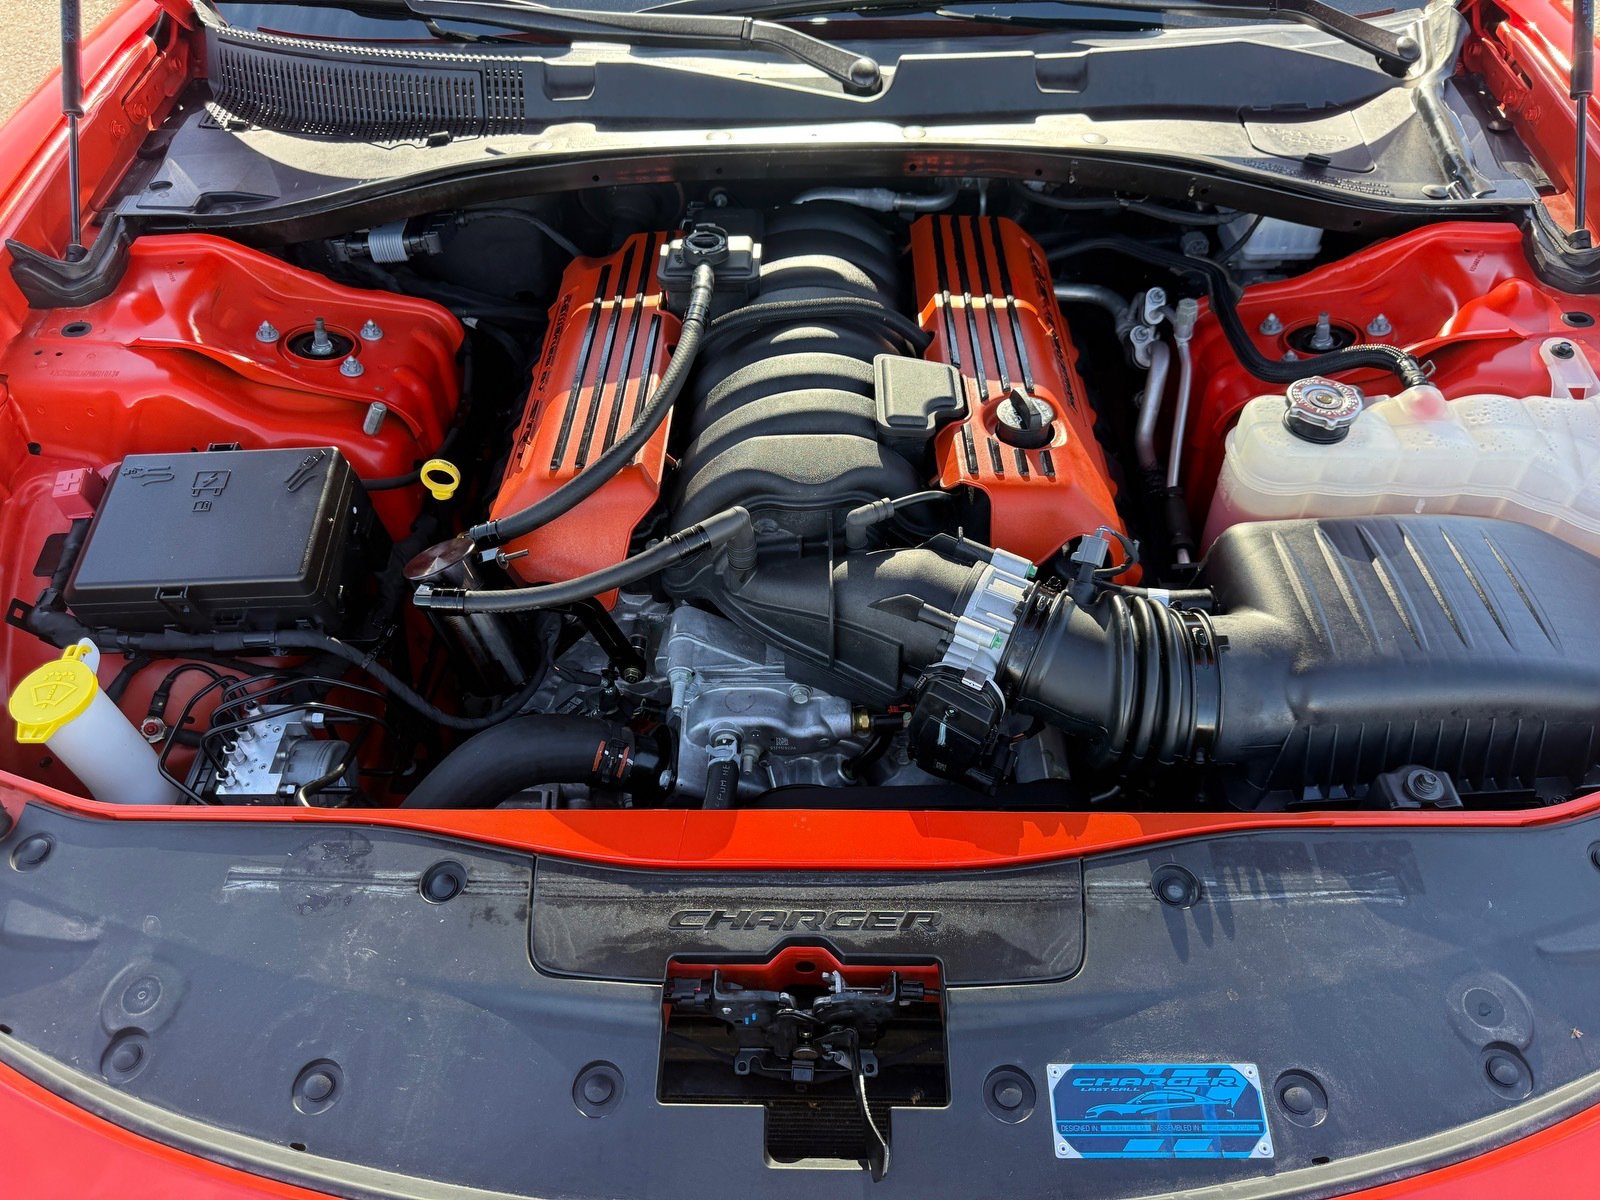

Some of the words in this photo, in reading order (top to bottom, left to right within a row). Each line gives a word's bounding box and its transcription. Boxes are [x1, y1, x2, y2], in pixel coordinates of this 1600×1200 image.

[667, 909, 942, 931] CHARGER
[1072, 1077, 1239, 1088] CHARGER
[1061, 1124, 1091, 1132] DESIGNED
[1157, 1124, 1192, 1132] ASSEMBLED
